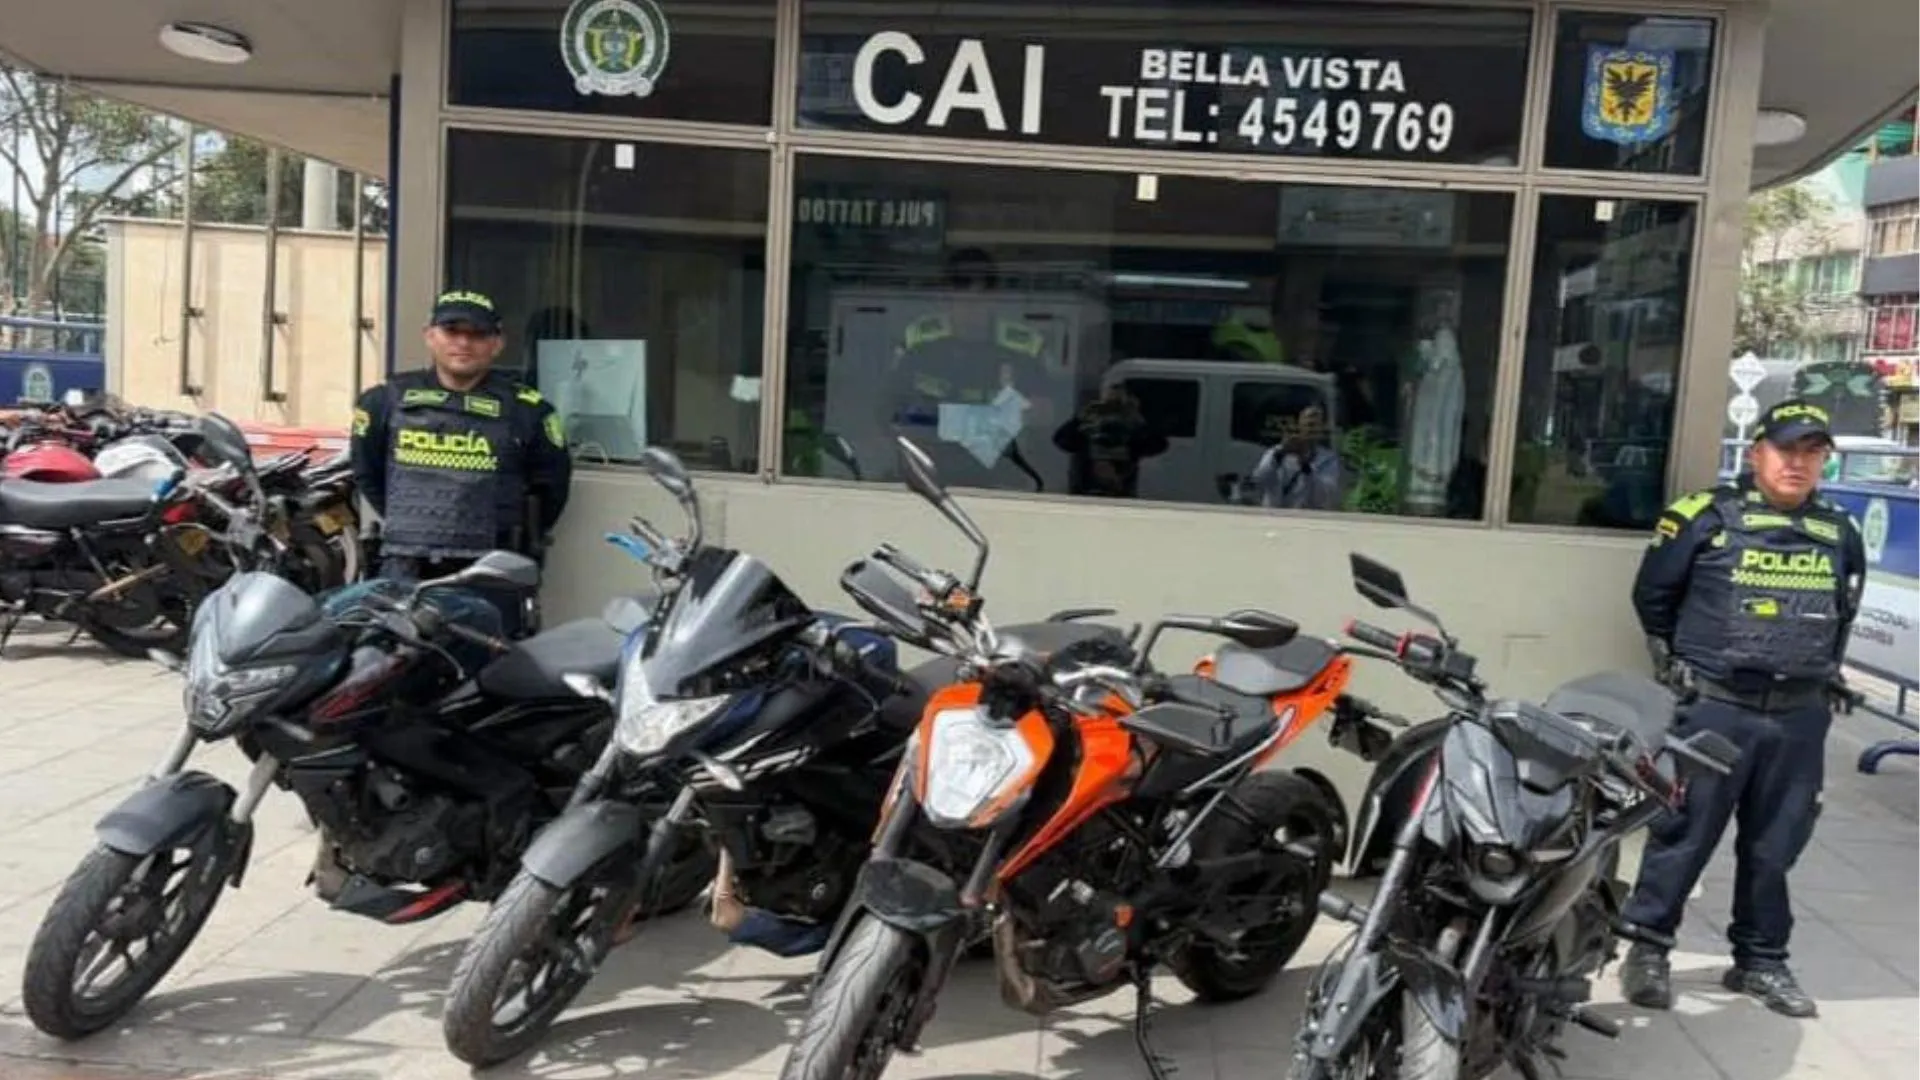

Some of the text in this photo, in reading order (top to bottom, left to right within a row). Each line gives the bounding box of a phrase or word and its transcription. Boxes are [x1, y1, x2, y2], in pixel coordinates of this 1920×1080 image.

[852, 31, 1045, 135] CAI
[1140, 49, 1405, 93] BELLA VISTA
[1100, 86, 1454, 152] TEL: 4549769
[398, 429, 492, 454] POLICÍA
[1742, 548, 1833, 574] POLICÍA
